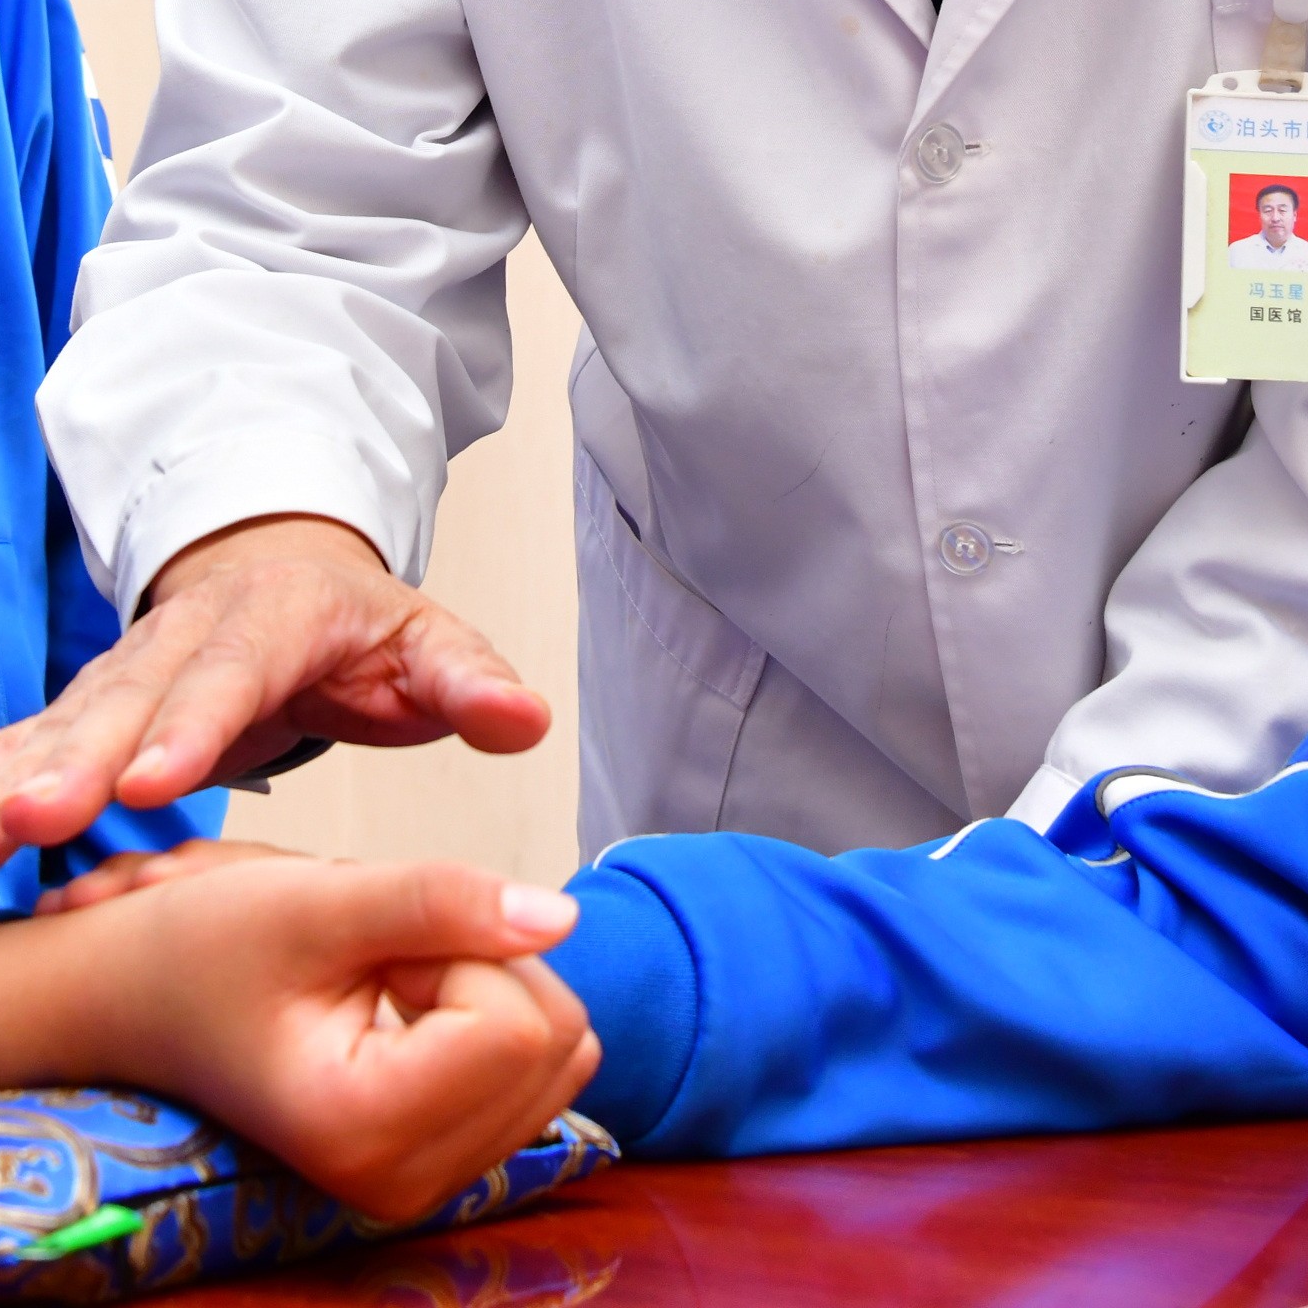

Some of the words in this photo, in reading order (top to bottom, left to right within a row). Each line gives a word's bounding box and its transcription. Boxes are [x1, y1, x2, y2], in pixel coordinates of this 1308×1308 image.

[1249, 282, 1303, 300] 冯玉星
[1249, 306, 1302, 324] 国医馆
